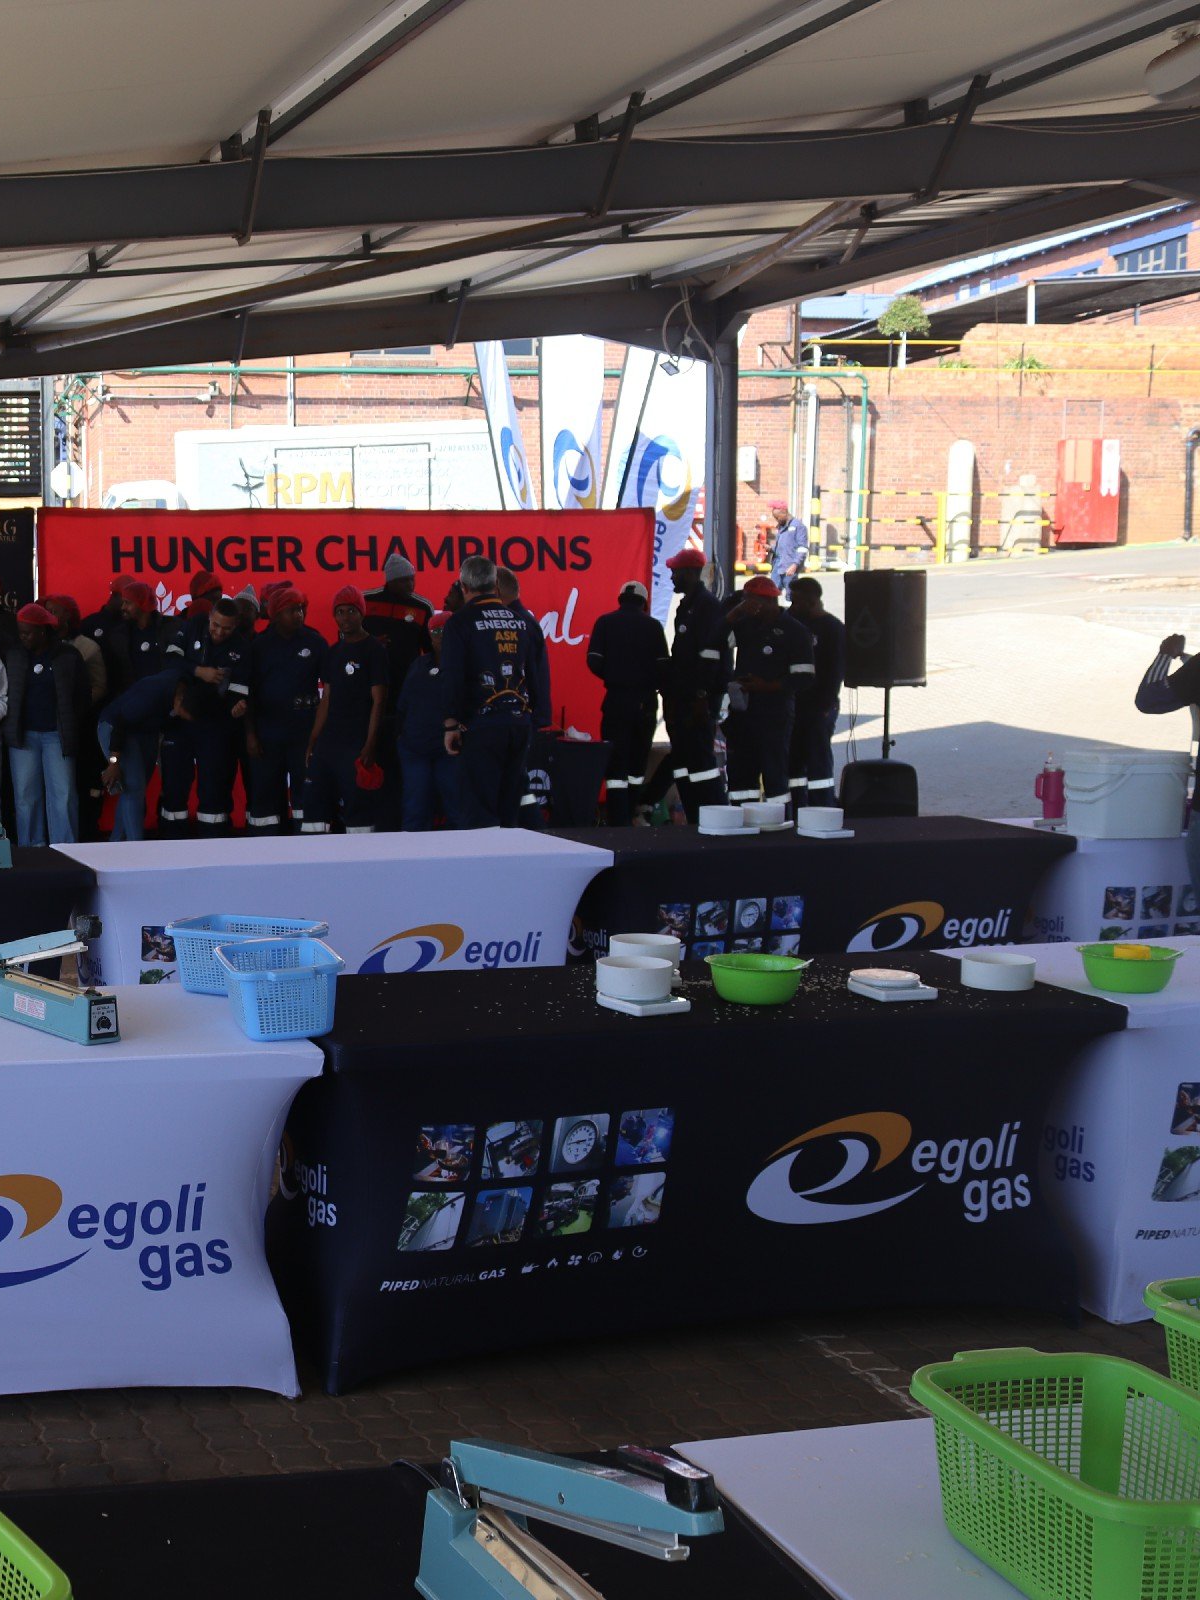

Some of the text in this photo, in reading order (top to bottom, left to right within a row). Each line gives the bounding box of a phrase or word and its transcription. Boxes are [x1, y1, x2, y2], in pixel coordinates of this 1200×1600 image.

[267, 471, 353, 505] RPM
[111, 535, 592, 573] HUNGER CHAMPIONS
[475, 620, 526, 632] ENERGY?
[481, 609, 514, 620] NEED
[494, 631, 519, 641] ASK
[498, 643, 518, 653] ME!
[583, 928, 607, 949] egoli
[943, 908, 1013, 946] egoli
[1033, 916, 1065, 935] egoli
[464, 931, 542, 970] egoli
[910, 1121, 1021, 1184] egoli
[1054, 1154, 1095, 1182] gas
[294, 1160, 327, 1195] egoli
[308, 1195, 337, 1227] gas
[963, 1174, 1031, 1223] gas
[67, 1183, 207, 1250] egoli
[1135, 1229, 1171, 1240] PIPED
[138, 1239, 233, 1291] gas
[379, 1267, 507, 1292] PIPED NATURAL GAS
